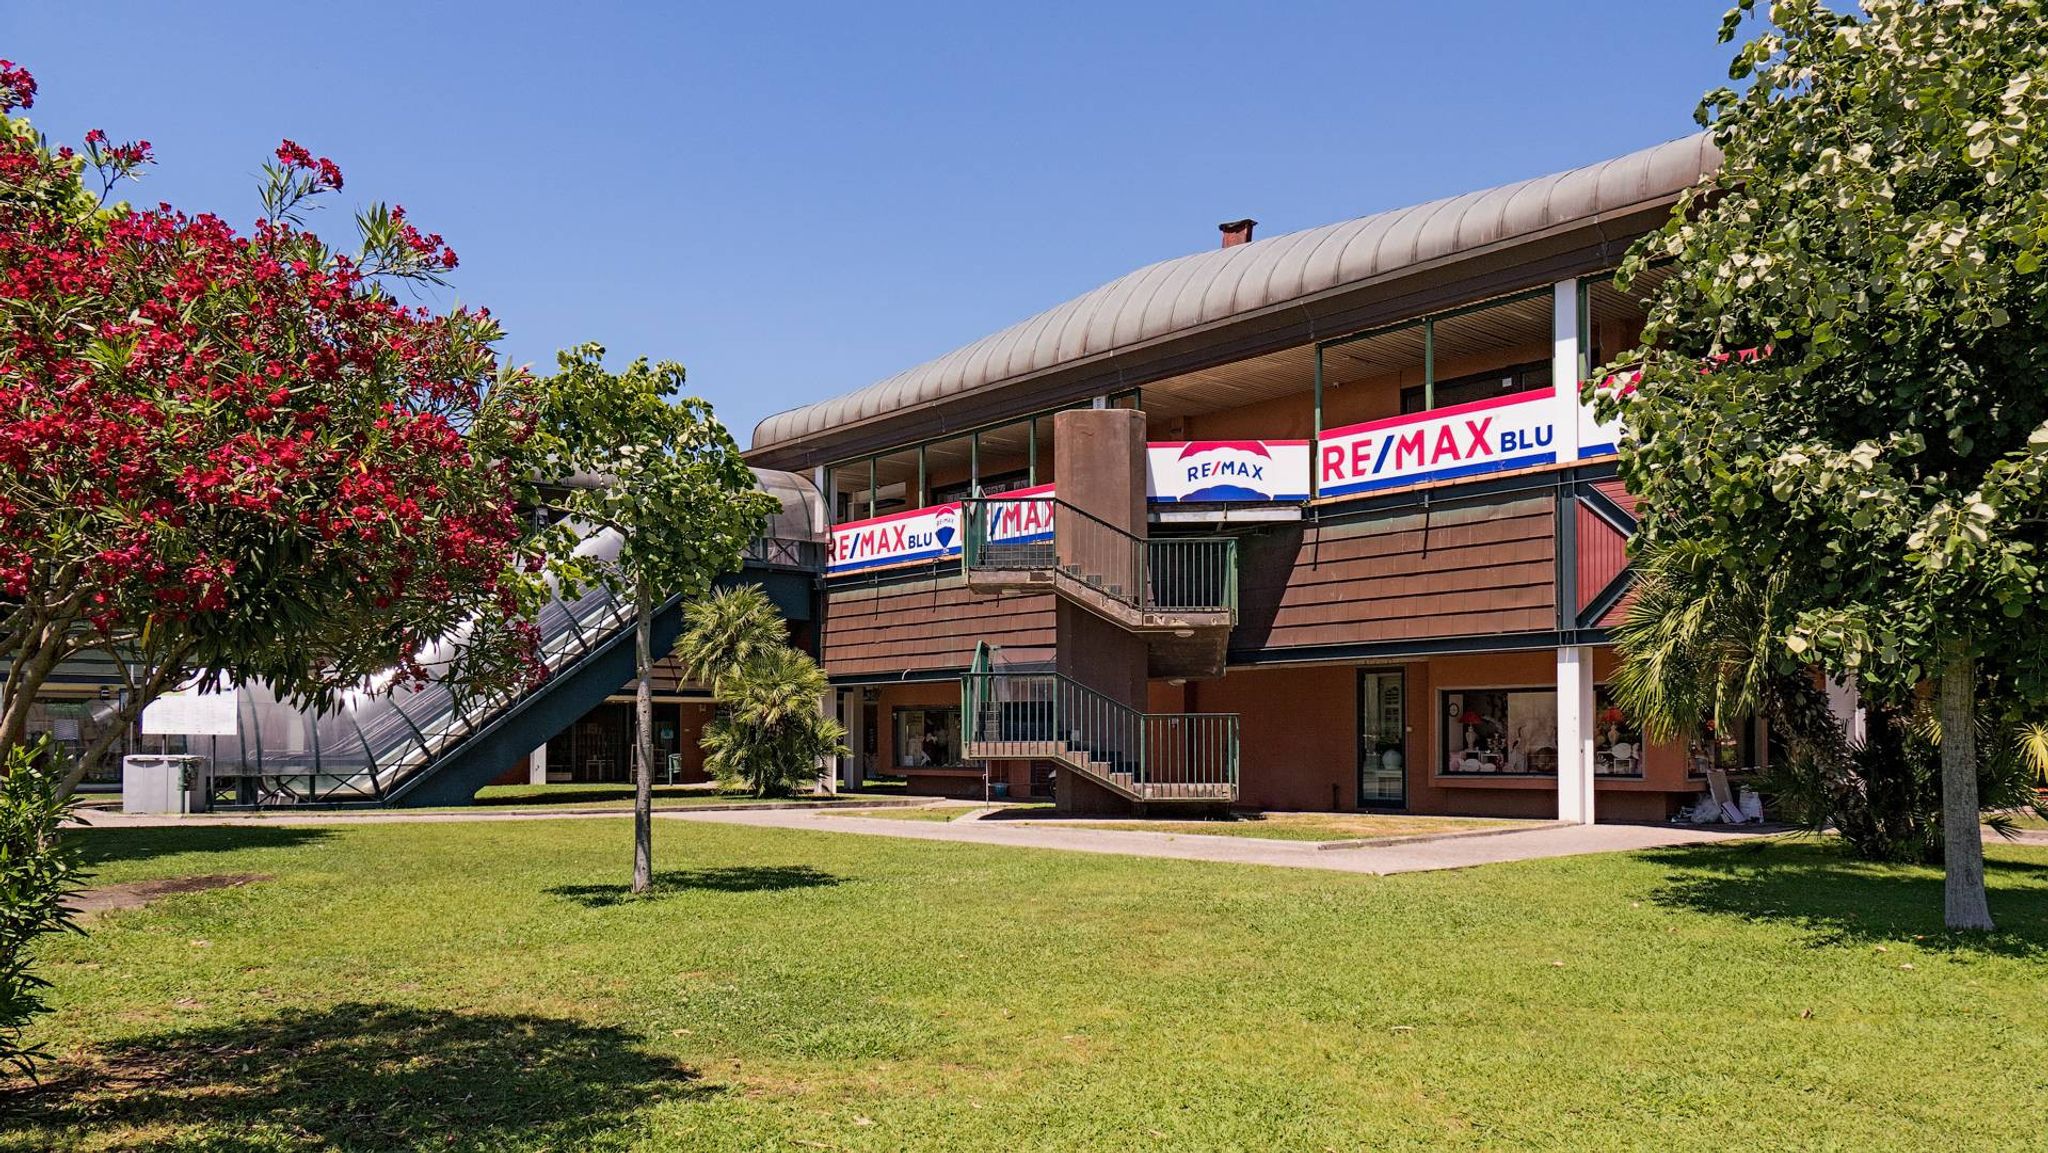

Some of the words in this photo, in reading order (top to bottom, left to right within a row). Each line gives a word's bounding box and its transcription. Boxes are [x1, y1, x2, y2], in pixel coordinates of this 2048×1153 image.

[1322, 416, 1494, 482] RE/MAX
[1500, 424, 1554, 453] BLU
[1187, 460, 1263, 482] RE/MAX
[986, 499, 1055, 537] /MAX
[827, 524, 906, 562] RE/MAX
[908, 532, 932, 550] BLU
